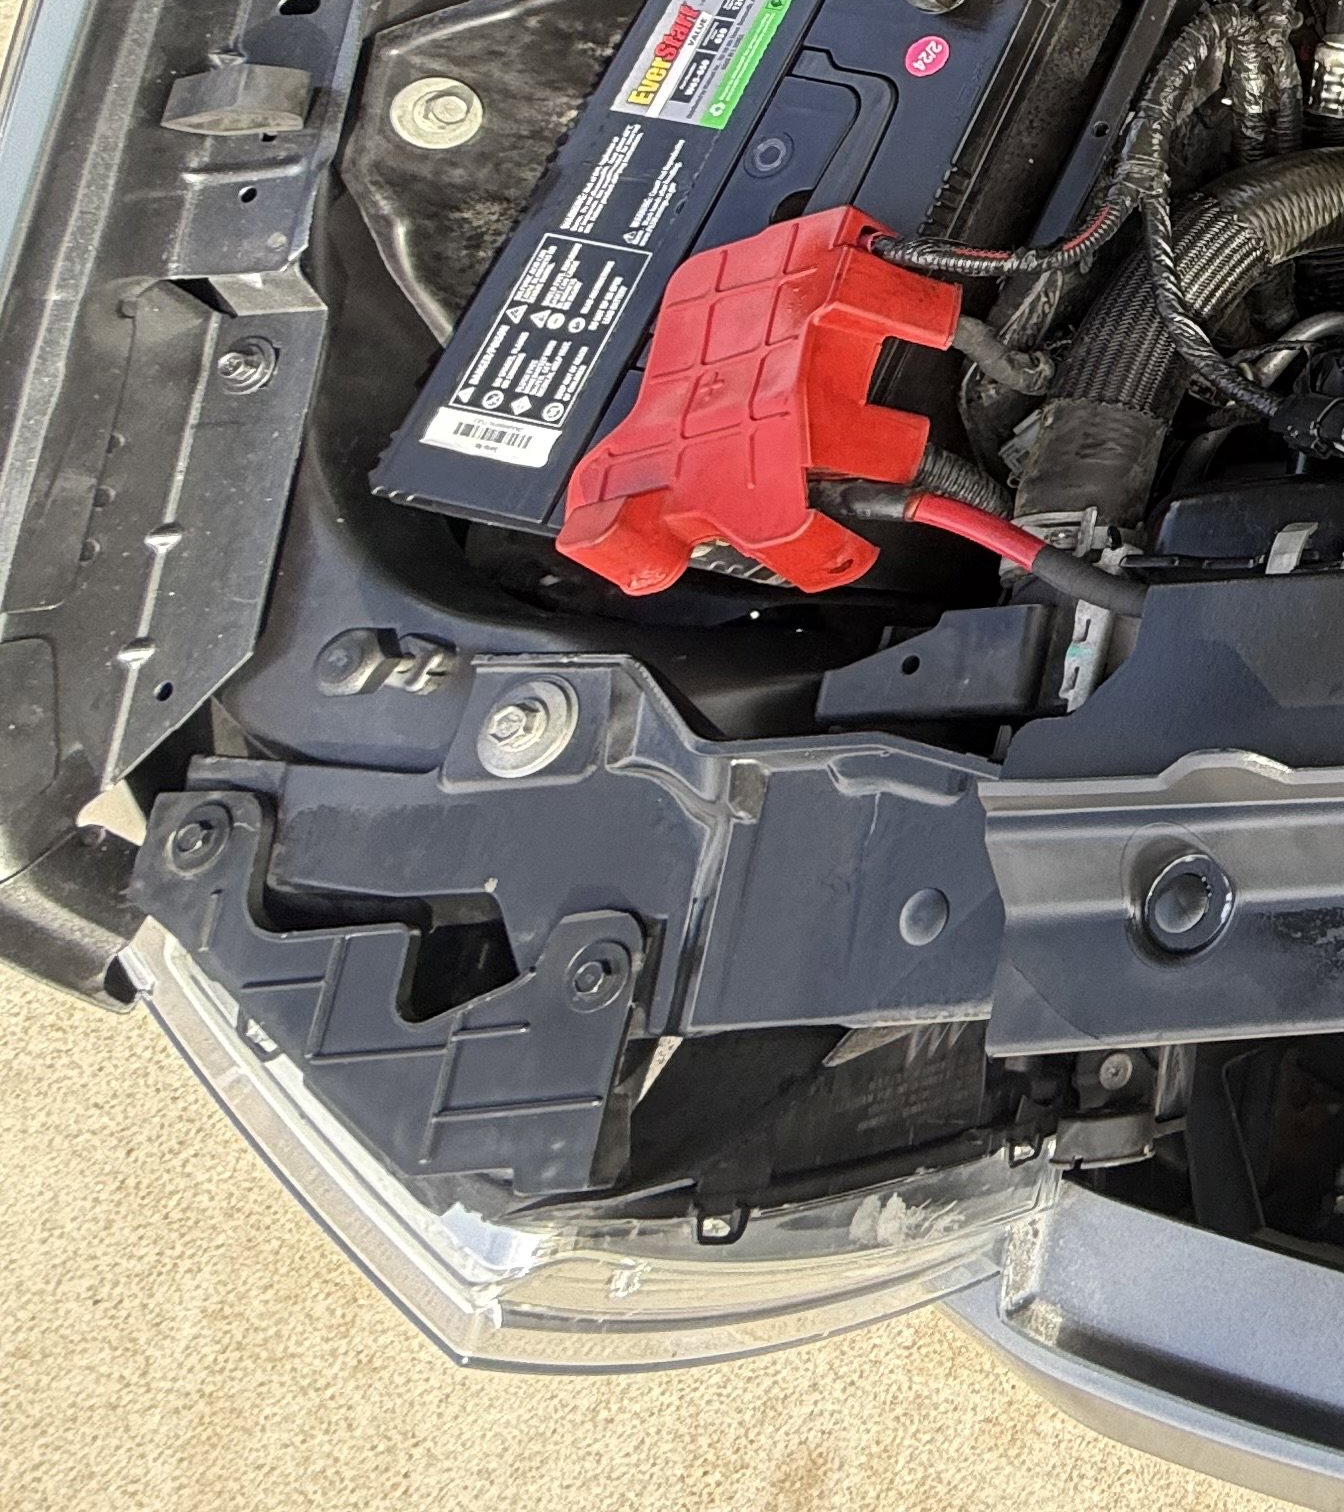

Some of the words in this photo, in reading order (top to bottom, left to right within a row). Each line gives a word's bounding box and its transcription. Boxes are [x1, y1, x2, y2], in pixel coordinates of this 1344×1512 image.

[686, 16, 708, 45] VALUE
[626, 3, 702, 105] EverStart
[911, 39, 942, 70] 2/24
